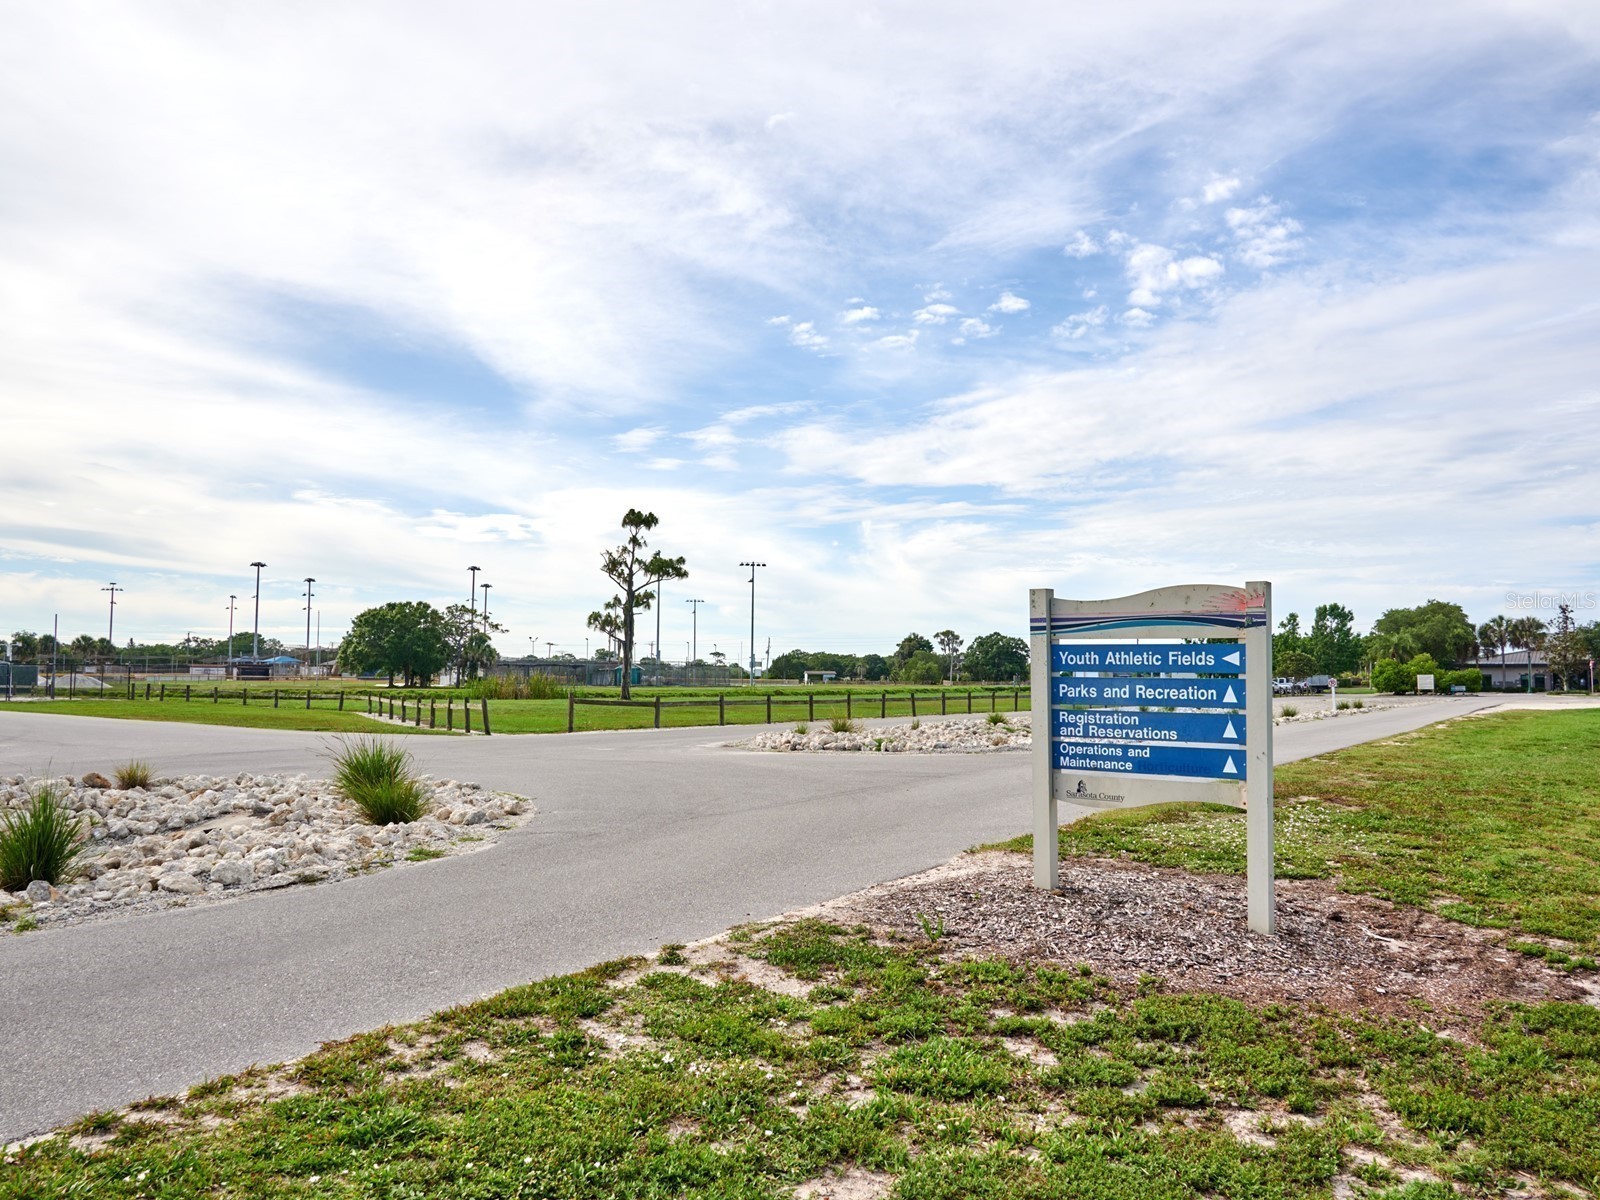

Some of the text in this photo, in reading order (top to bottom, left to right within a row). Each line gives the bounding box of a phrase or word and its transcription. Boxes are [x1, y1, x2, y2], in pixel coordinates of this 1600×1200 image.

[1059, 652, 1214, 665] Youth Athletic Fields
[1059, 685, 1216, 700] Parks and Recreation
[1060, 712, 1138, 727] Registration
[1060, 725, 1177, 740] and Reservations
[1060, 744, 1150, 758] Operations and
[1060, 757, 1210, 774] Maintenance Horticulture
[1066, 790, 1125, 803] Sarasota County
